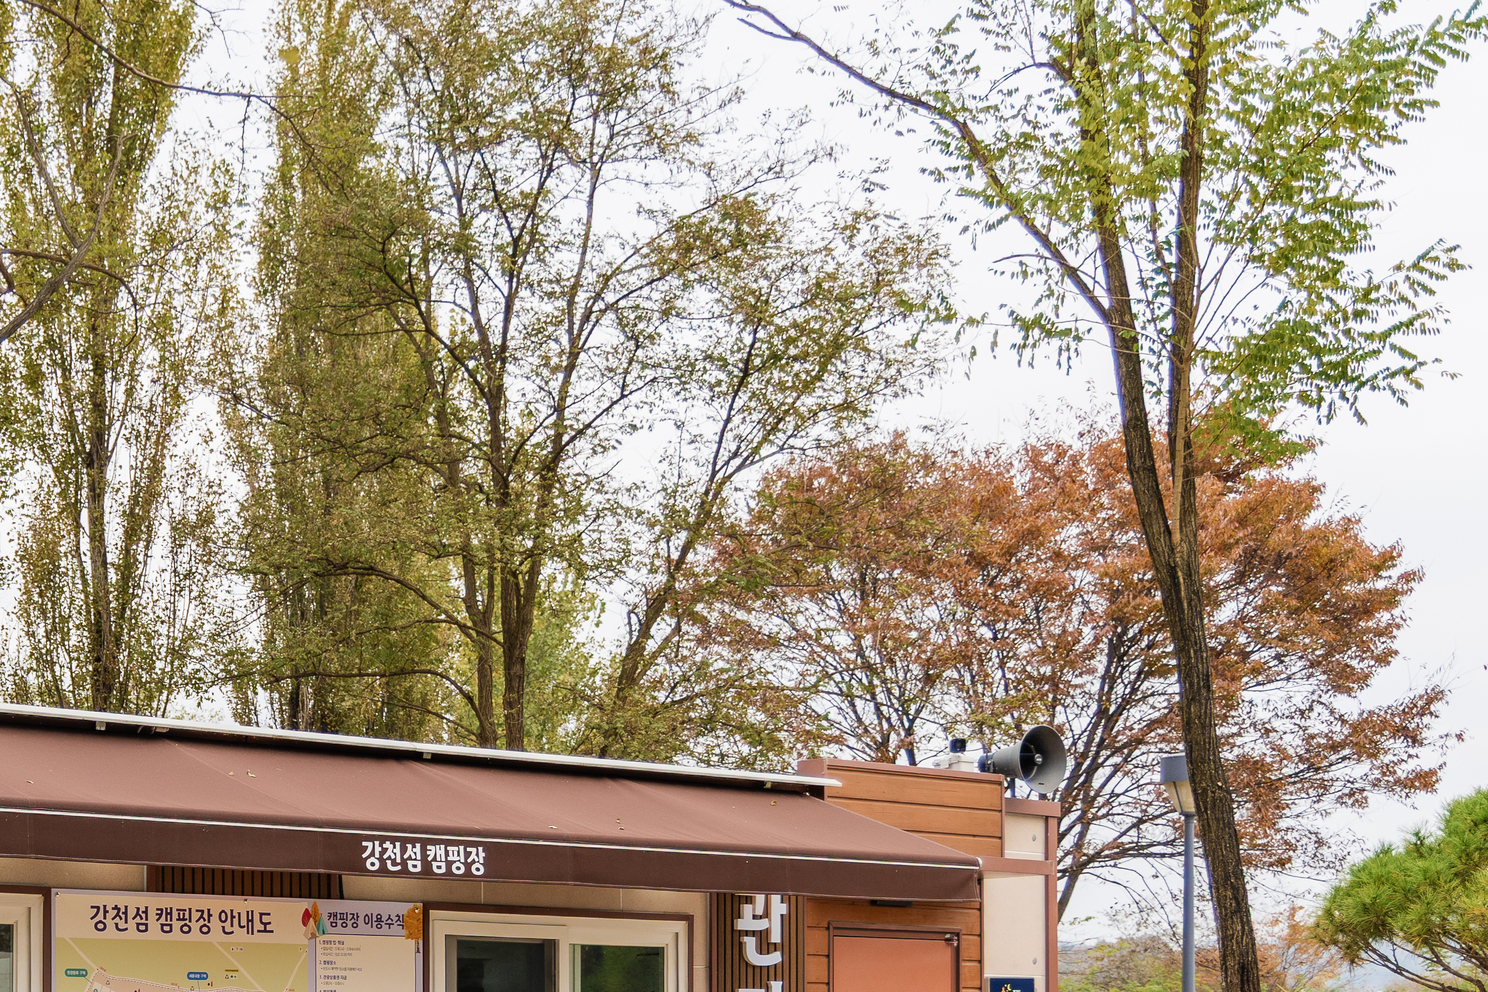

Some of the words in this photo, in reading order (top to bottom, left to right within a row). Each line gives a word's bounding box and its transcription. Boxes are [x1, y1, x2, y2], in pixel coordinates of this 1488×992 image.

[362, 840, 422, 873] 강천섬
[426, 844, 486, 876] 캠핑장
[89, 904, 150, 934] 강천섬
[154, 906, 213, 935] 캠핑장
[217, 908, 275, 936] 안내도
[326, 912, 360, 929] 캠핑장
[362, 912, 405, 931] 이용수칙
